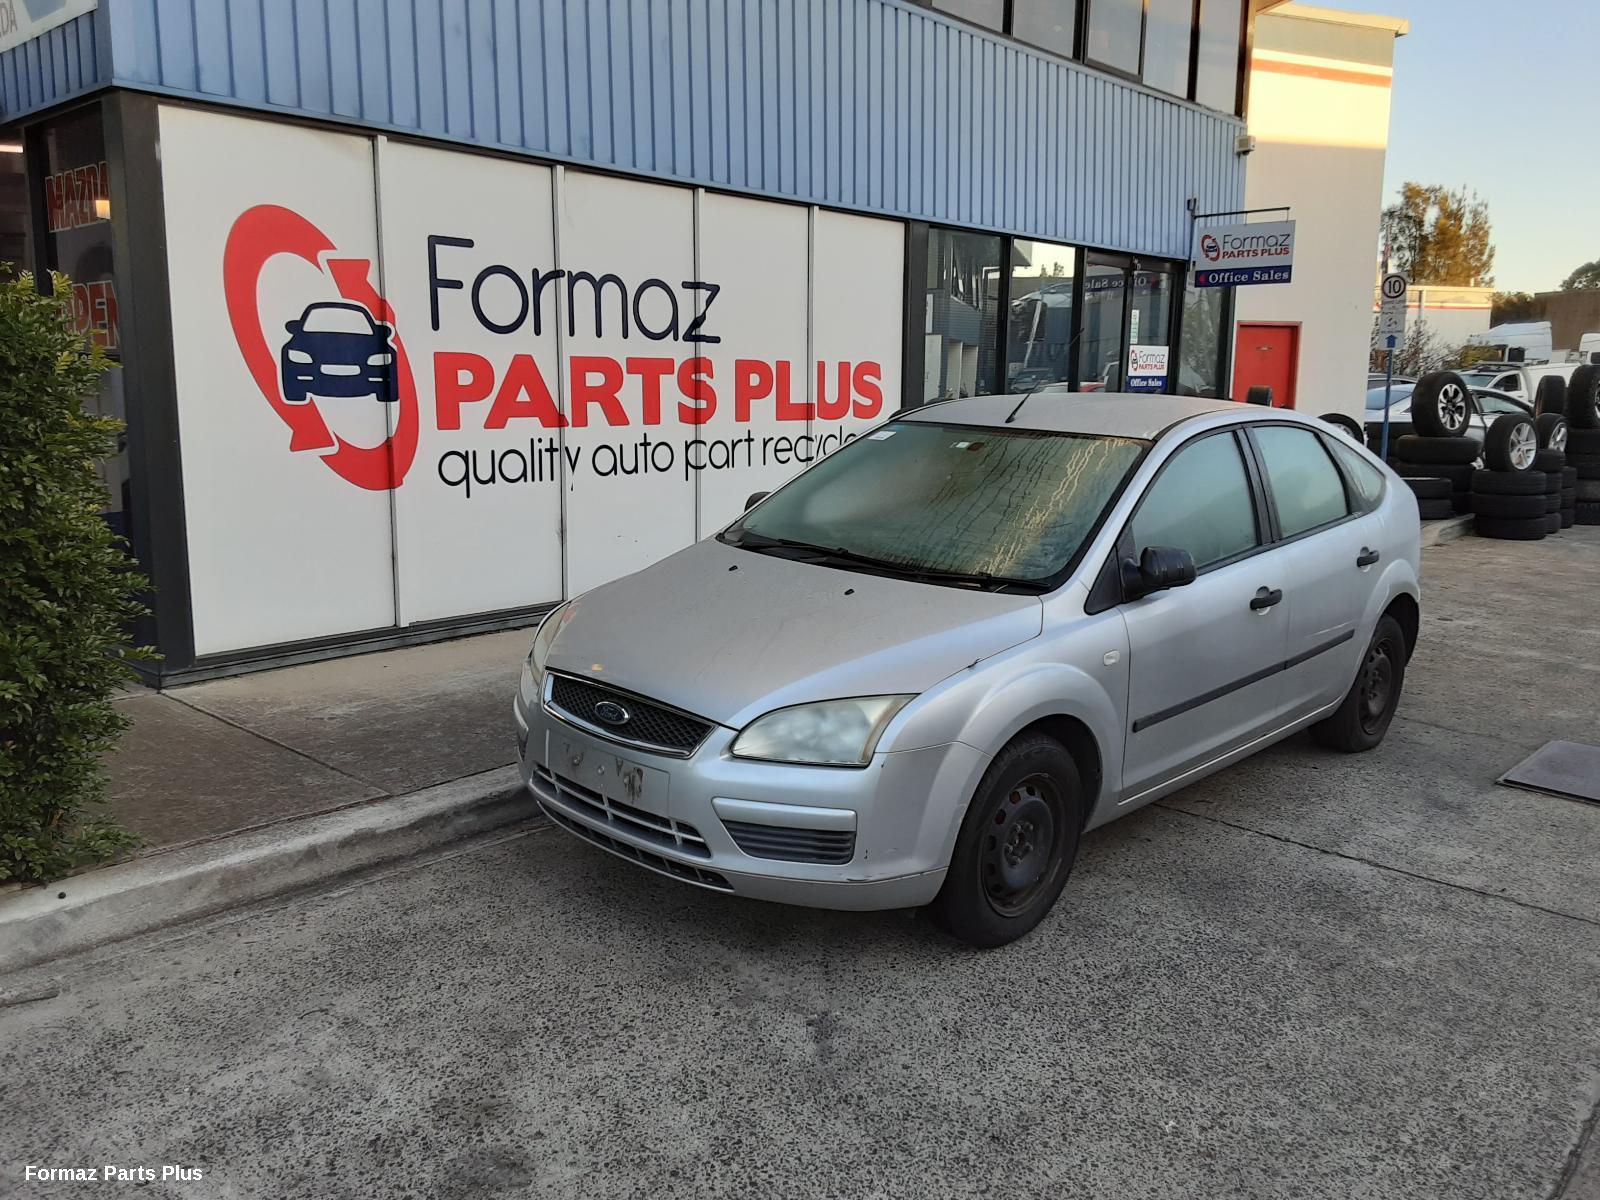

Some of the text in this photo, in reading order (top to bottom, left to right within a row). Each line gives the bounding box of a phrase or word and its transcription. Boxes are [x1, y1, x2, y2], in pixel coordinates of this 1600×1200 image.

[1222, 234, 1290, 250] Formaz
[1222, 247, 1289, 259] PARTS PLUS
[1208, 270, 1289, 284] Office Sales
[427, 234, 721, 344] Formaz
[1388, 280, 1401, 294] 10
[1139, 350, 1165, 363] Formaz
[433, 351, 883, 431] PARTS PLUS
[438, 437, 582, 499] quality
[592, 432, 674, 478] auto
